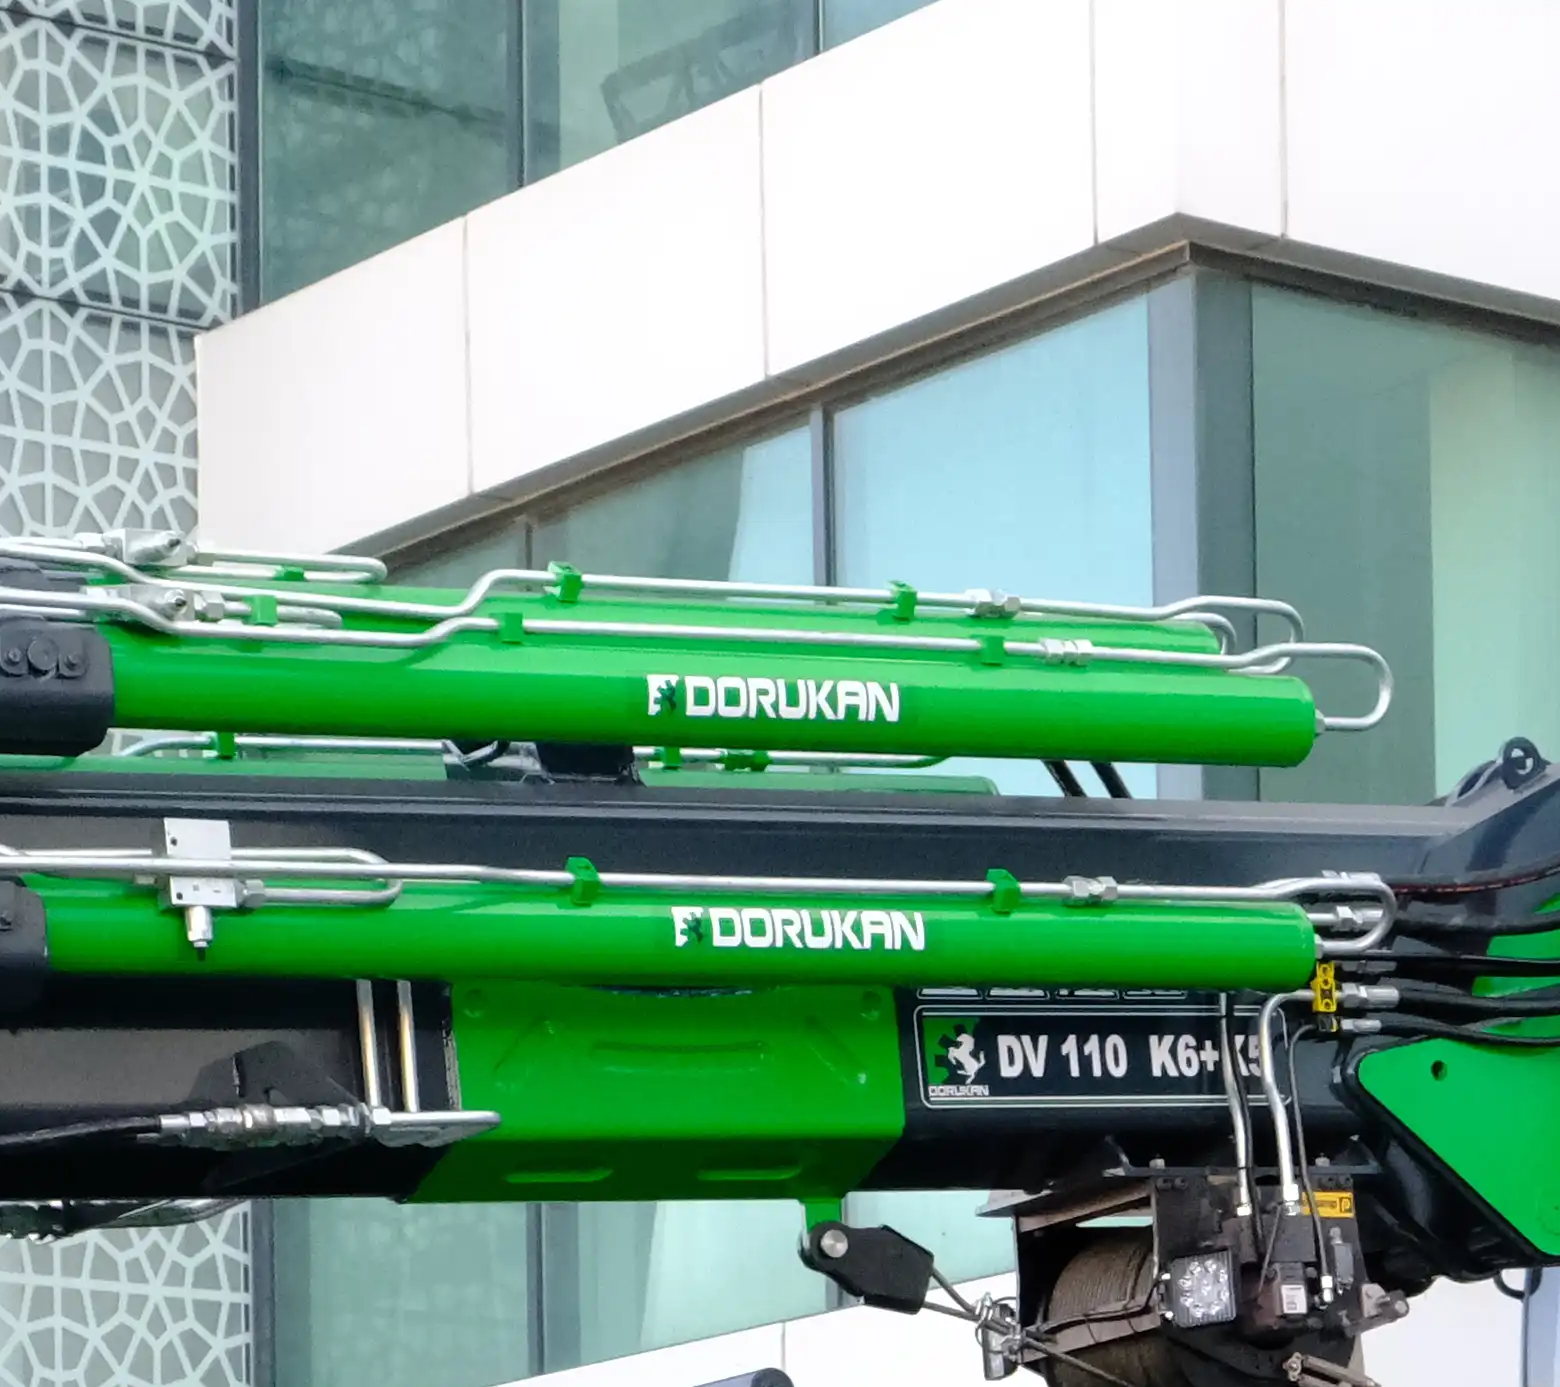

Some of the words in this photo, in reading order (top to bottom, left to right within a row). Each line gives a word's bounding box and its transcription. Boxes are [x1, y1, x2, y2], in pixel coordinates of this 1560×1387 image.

[684, 675, 900, 723] DORUKAN
[708, 908, 926, 951] DORUKAN
[996, 1034, 1049, 1078] DV
[1060, 1034, 1128, 1078] 110
